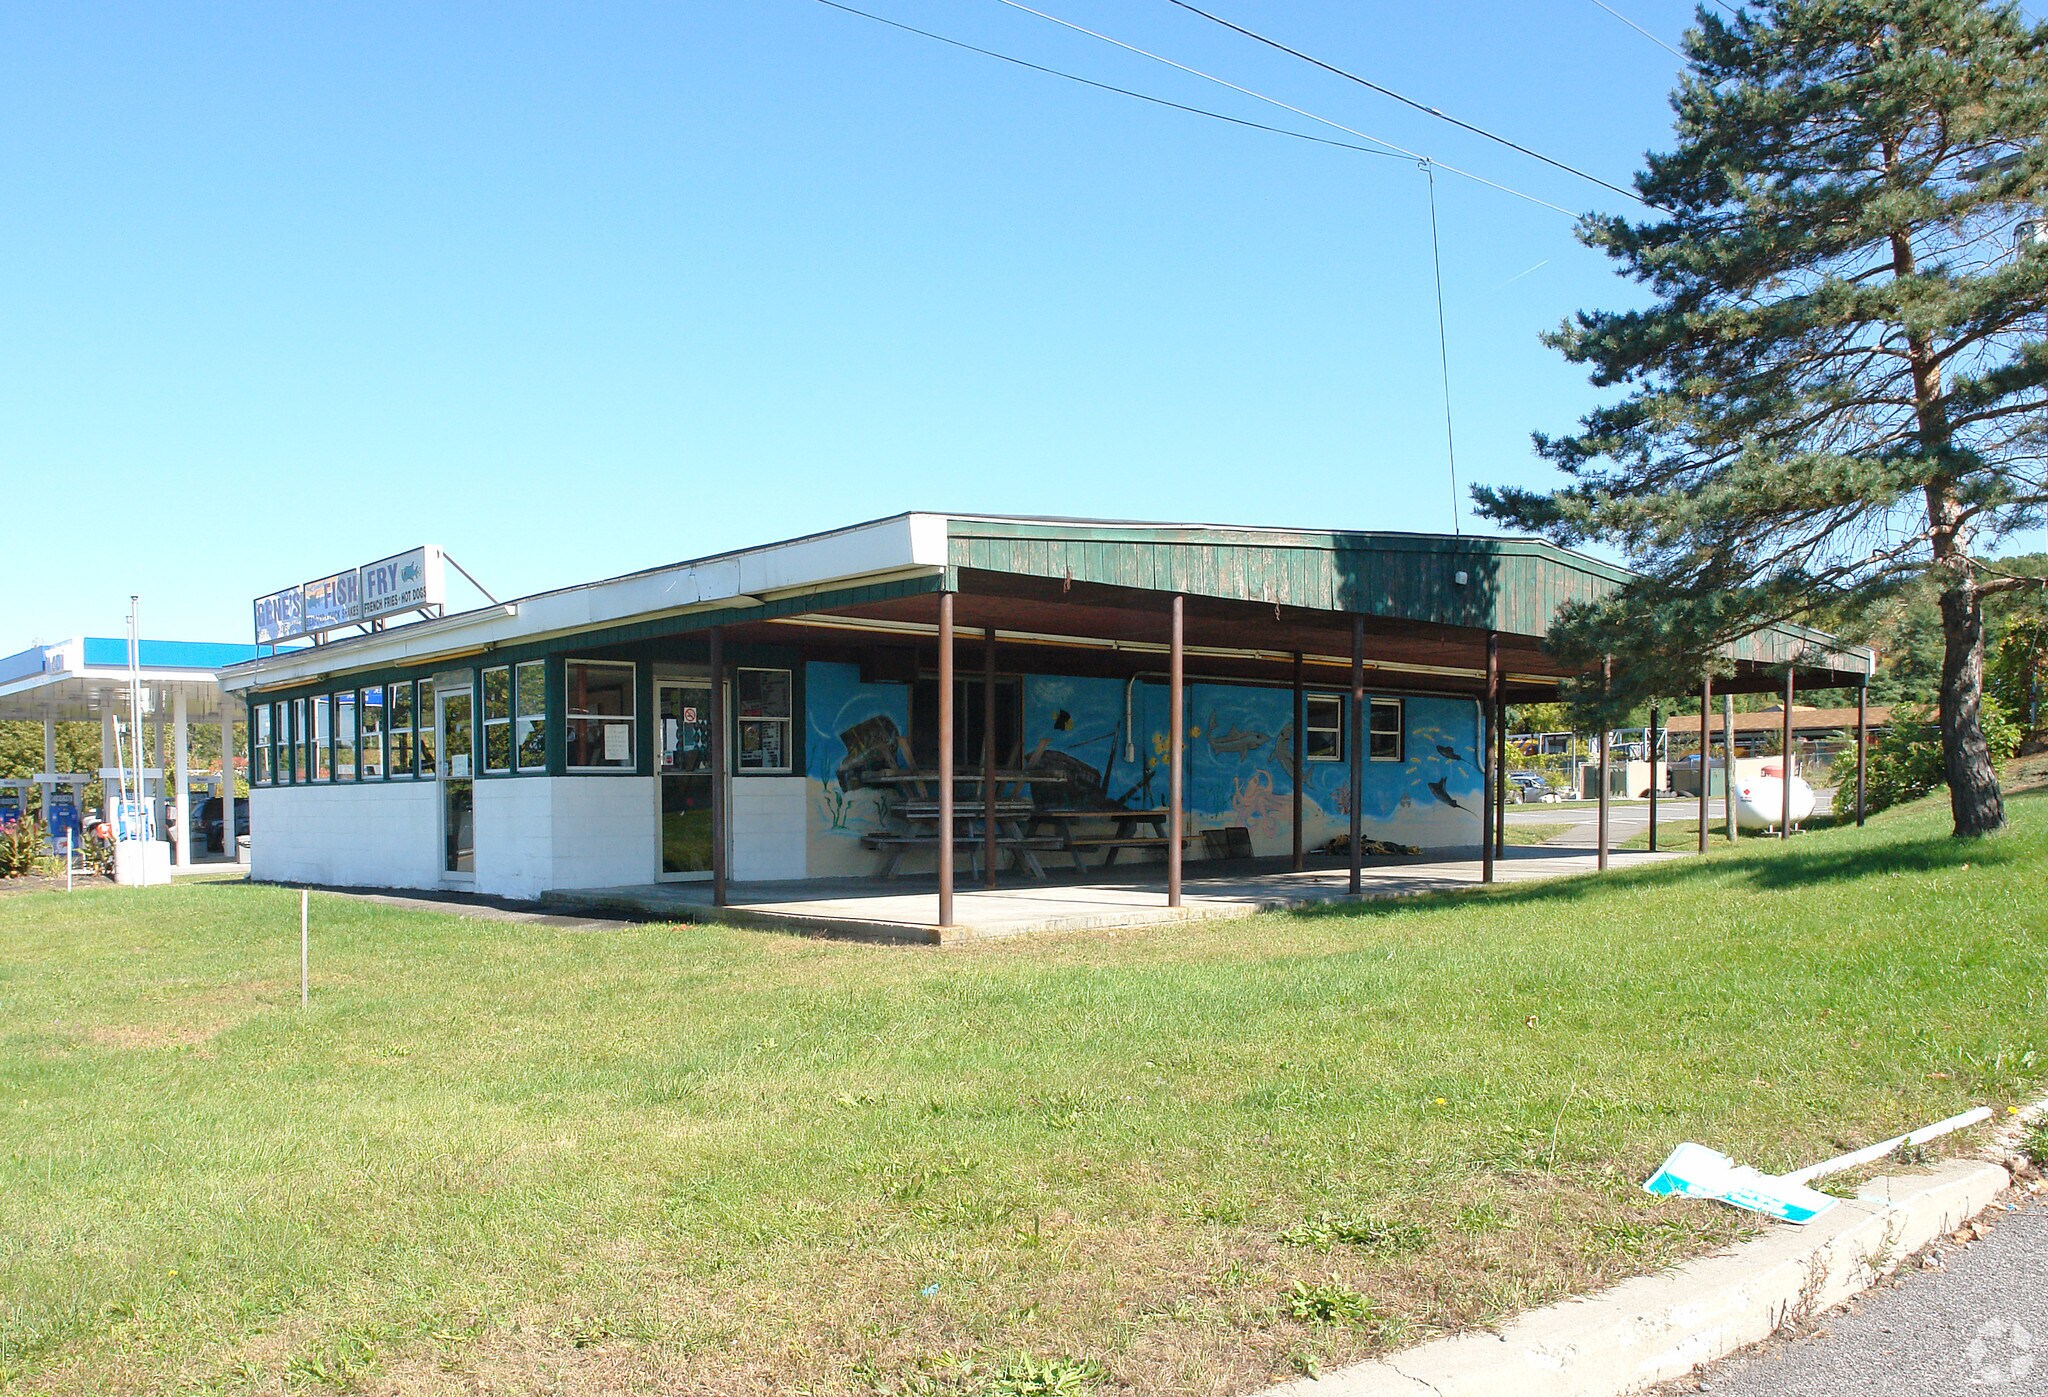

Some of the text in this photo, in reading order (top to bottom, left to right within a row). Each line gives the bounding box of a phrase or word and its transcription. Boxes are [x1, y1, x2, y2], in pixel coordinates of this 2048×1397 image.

[323, 575, 358, 610] FISH
[367, 562, 398, 599] FRY
[364, 600, 383, 614] FRENCH
[383, 594, 398, 609] FRIES
[401, 590, 411, 604] HOT
[413, 586, 426, 601] DOGS
